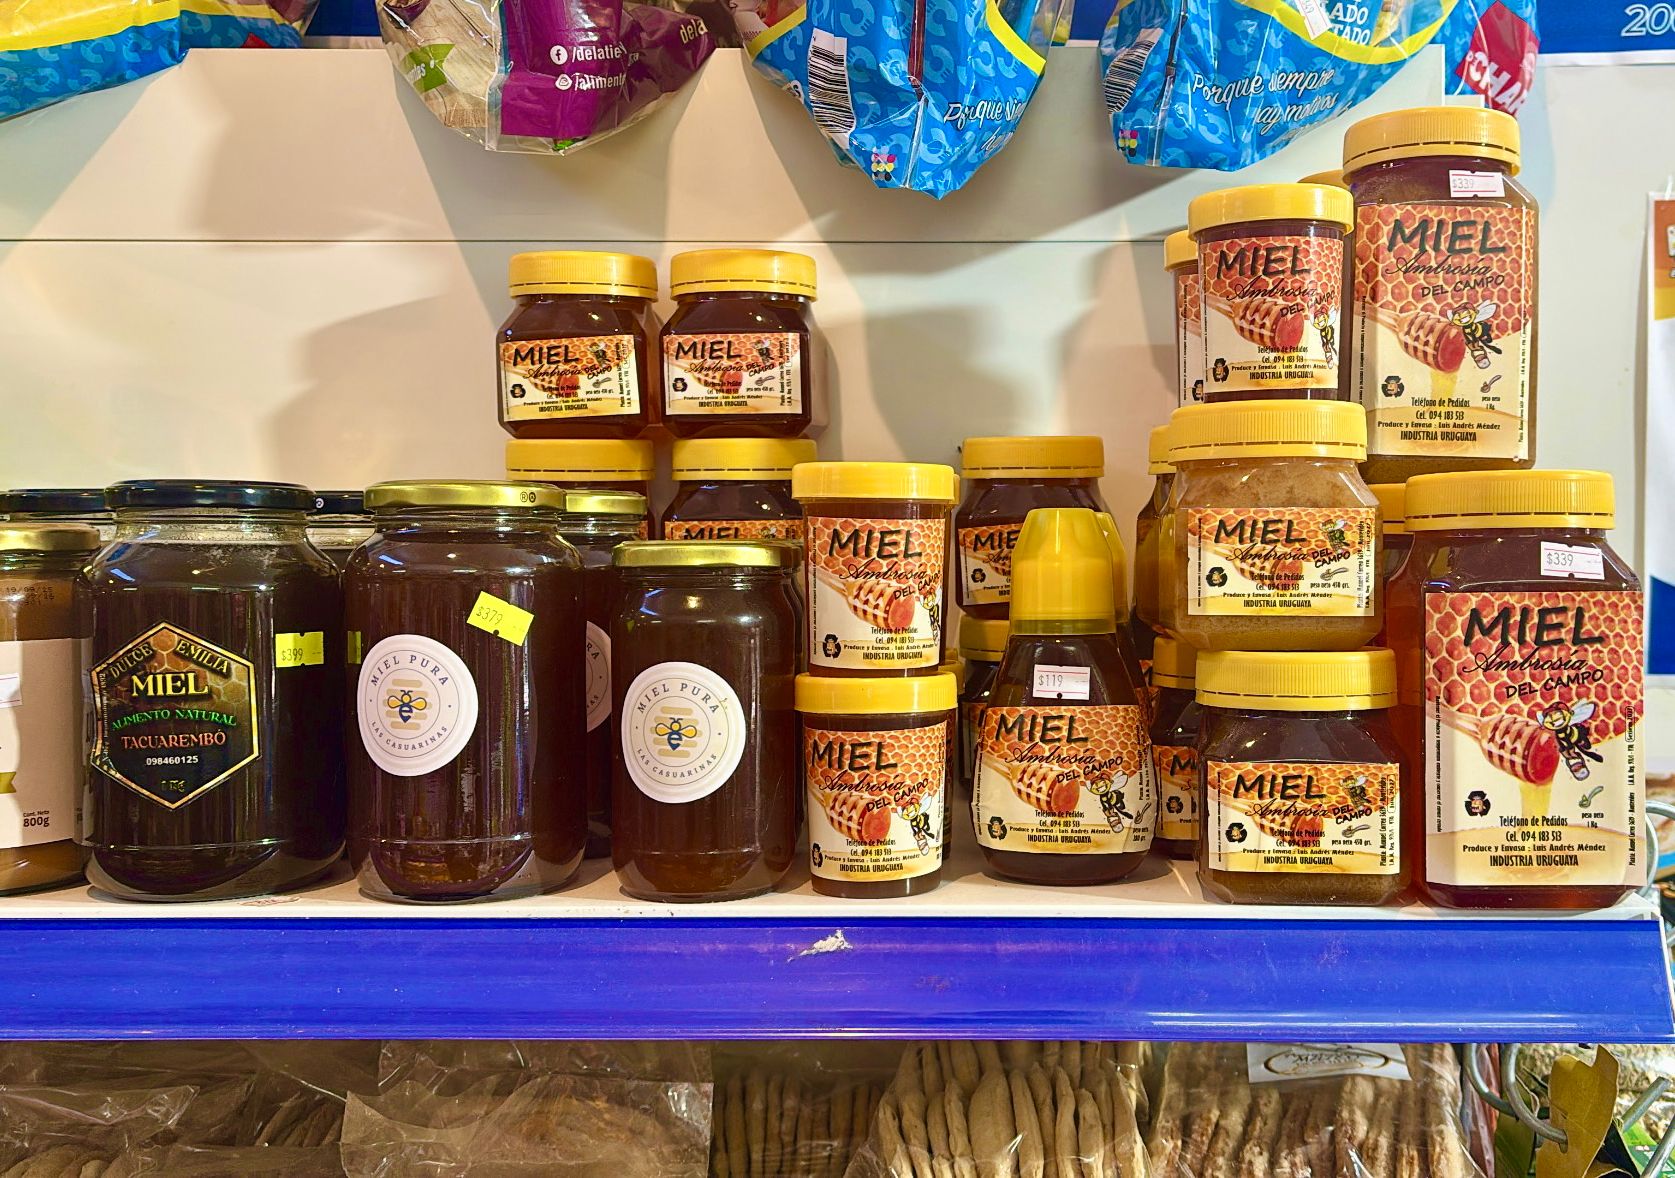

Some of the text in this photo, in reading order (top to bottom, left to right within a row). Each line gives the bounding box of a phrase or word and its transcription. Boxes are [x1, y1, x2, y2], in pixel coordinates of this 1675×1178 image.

[1192, 73, 1264, 110] Porque
[1452, 178, 1473, 189] $339
[1387, 219, 1506, 255] MIEL
[1217, 246, 1312, 280] MIEL
[1385, 250, 1492, 275] Ambrosía
[1421, 275, 1505, 297] DEL CAMPO
[1279, 304, 1304, 317] DEL
[513, 345, 579, 366] MIEL
[675, 340, 742, 360] MIEL
[1274, 356, 1285, 364] 094
[584, 366, 599, 374] DEL
[587, 366, 612, 380] CAMPO
[749, 364, 775, 377] CAMPO
[1249, 371, 1314, 380] INDUSTRIA URUGUAYA
[1411, 397, 1470, 408] Teléfono de Pedidos
[1416, 411, 1464, 420] Cel. 094 183 513
[1401, 431, 1477, 442] INDUSTRIA URUGUAYA
[973, 530, 1021, 552] MIE
[1214, 518, 1306, 545] MIEL
[829, 528, 922, 558] MIEL
[1225, 543, 1312, 562] Ambrosía
[1312, 548, 1332, 560] DEL
[1314, 552, 1350, 568] CAMPO
[1546, 553, 1574, 567] $339
[839, 557, 927, 580] Ambrosía
[893, 588, 915, 600] DEL
[1291, 583, 1300, 591] 513
[1243, 599, 1312, 608] INDUSTRIA URUGUAYA
[475, 605, 504, 626] $379
[1463, 606, 1604, 647] MIEL
[110, 638, 231, 679] DULCE EMILIA
[281, 647, 304, 661] $399
[863, 652, 895, 660] INDUSTRIA
[1462, 641, 1588, 673] Ambrosía
[371, 654, 449, 687] MIEL PURA
[130, 671, 210, 697] MIEL
[1038, 675, 1063, 687] $119
[1505, 668, 1604, 699] DEL CAMPO
[637, 682, 720, 714] MIEL PURA
[111, 708, 237, 731] ALIMENTO NATURAL
[995, 713, 1088, 744] MIEL
[120, 729, 227, 750] TACUAREMBÓ
[371, 721, 448, 751] LAS CASUARINAS
[146, 755, 199, 766] 098460125
[811, 739, 898, 771] MIEL
[1004, 741, 1097, 764] Ambrosía
[638, 748, 717, 778] LAS CASUARINAS
[1056, 756, 1123, 784] DEL CAMPO
[819, 769, 906, 792] Ambrosía
[1233, 774, 1326, 799] MIEL
[866, 778, 929, 812] DEL CAMPO
[1244, 798, 1332, 818] Ambrosía
[1332, 805, 1353, 817] DEL
[1335, 808, 1372, 825] CAMPO
[23, 817, 50, 828] 800g
[1499, 815, 1568, 827] Teléfono de Pedidos
[1027, 834, 1092, 843] INDUSTRIA URUGUAYA
[1505, 831, 1562, 842] Cel. 094 183 513
[1533, 844, 1547, 852] Luis
[1549, 843, 1575, 852] Andrés
[1577, 844, 1606, 852] Méndez
[840, 863, 903, 872] INDUSTRIA URUGUAYA
[1263, 857, 1333, 865] INDUSTRIA URUGUAYA
[1489, 855, 1579, 866] INDUSTRIA URUGUAYA
